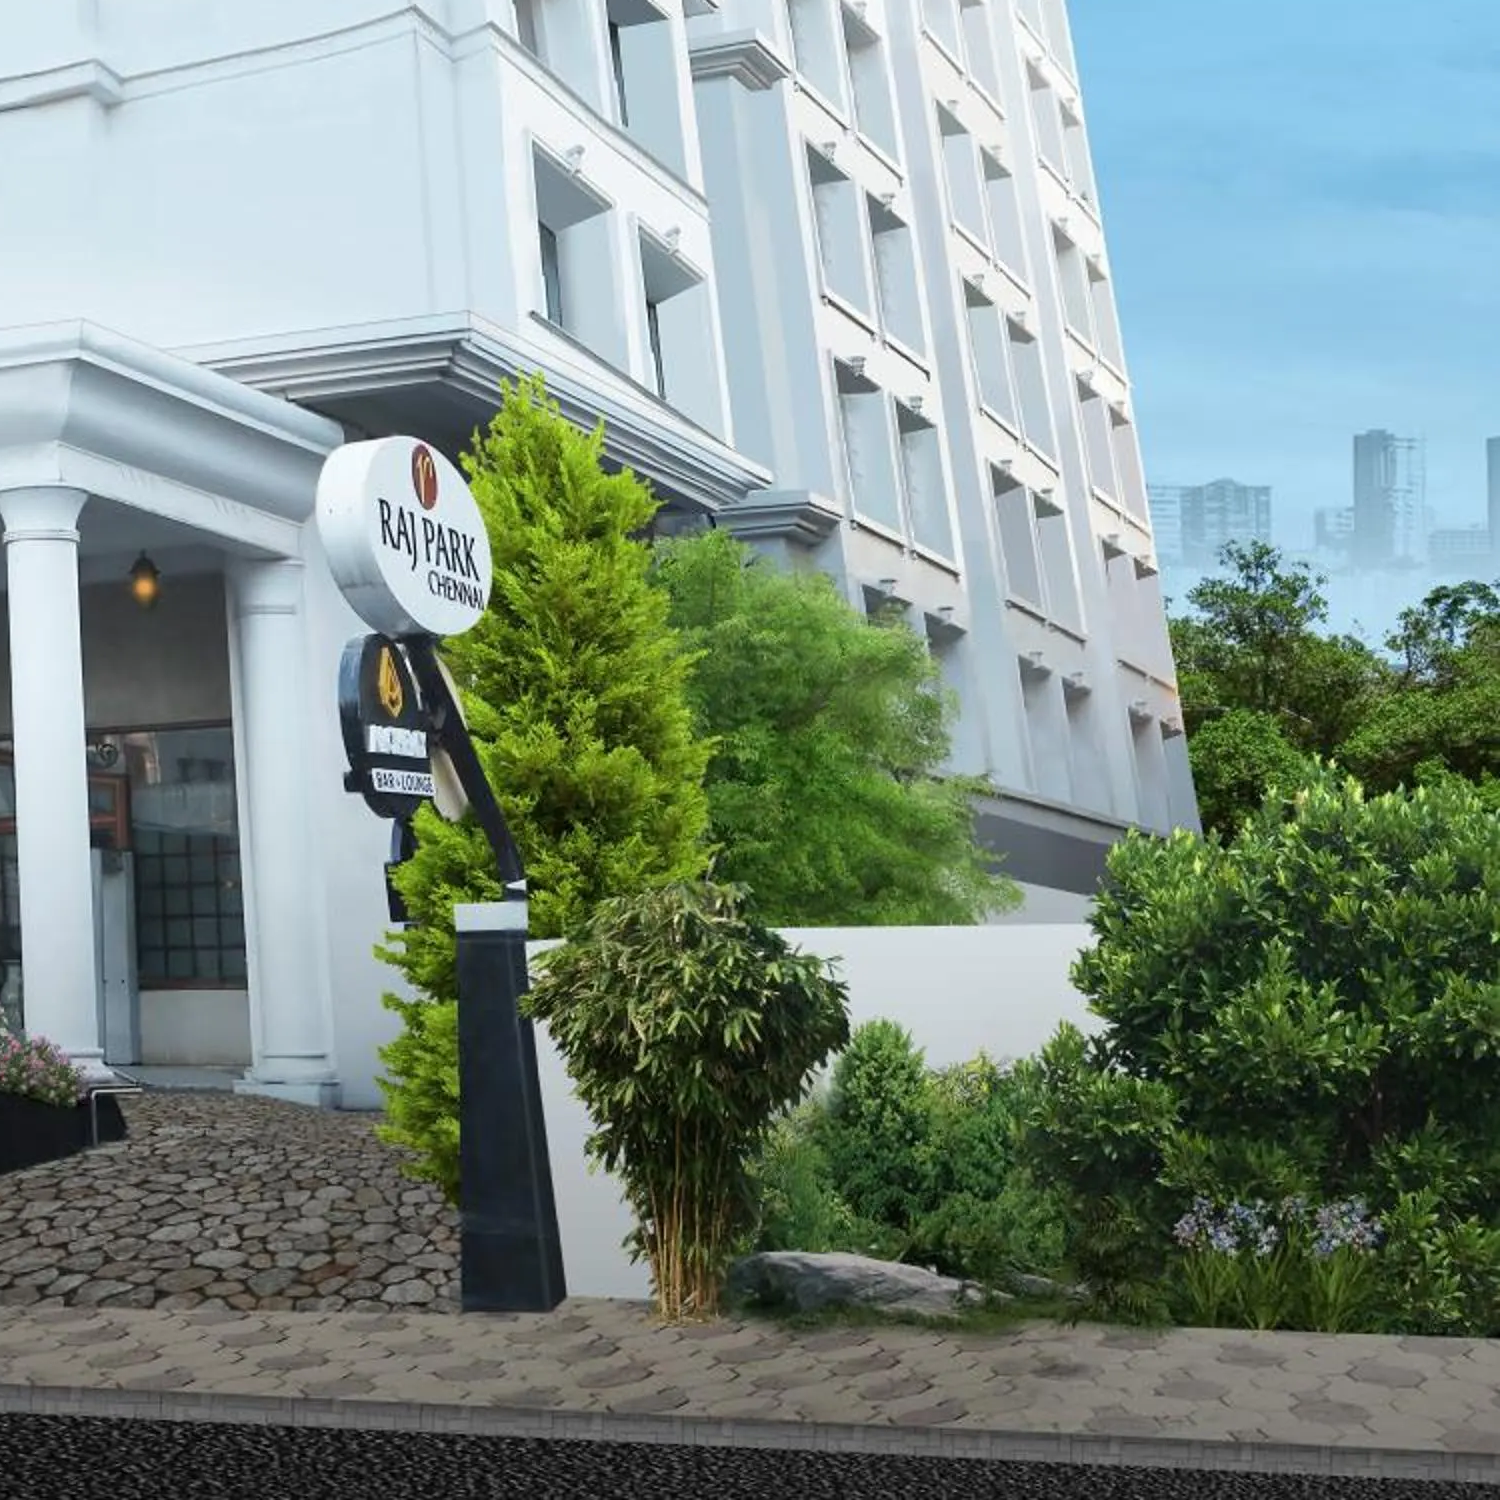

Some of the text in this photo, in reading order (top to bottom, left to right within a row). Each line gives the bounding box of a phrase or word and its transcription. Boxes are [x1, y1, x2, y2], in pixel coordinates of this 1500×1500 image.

[377, 498, 481, 582] RAJ PARK
[428, 570, 485, 611] CHENNAI
[376, 771, 395, 789] BAR
[402, 773, 434, 794] LOUNGE
